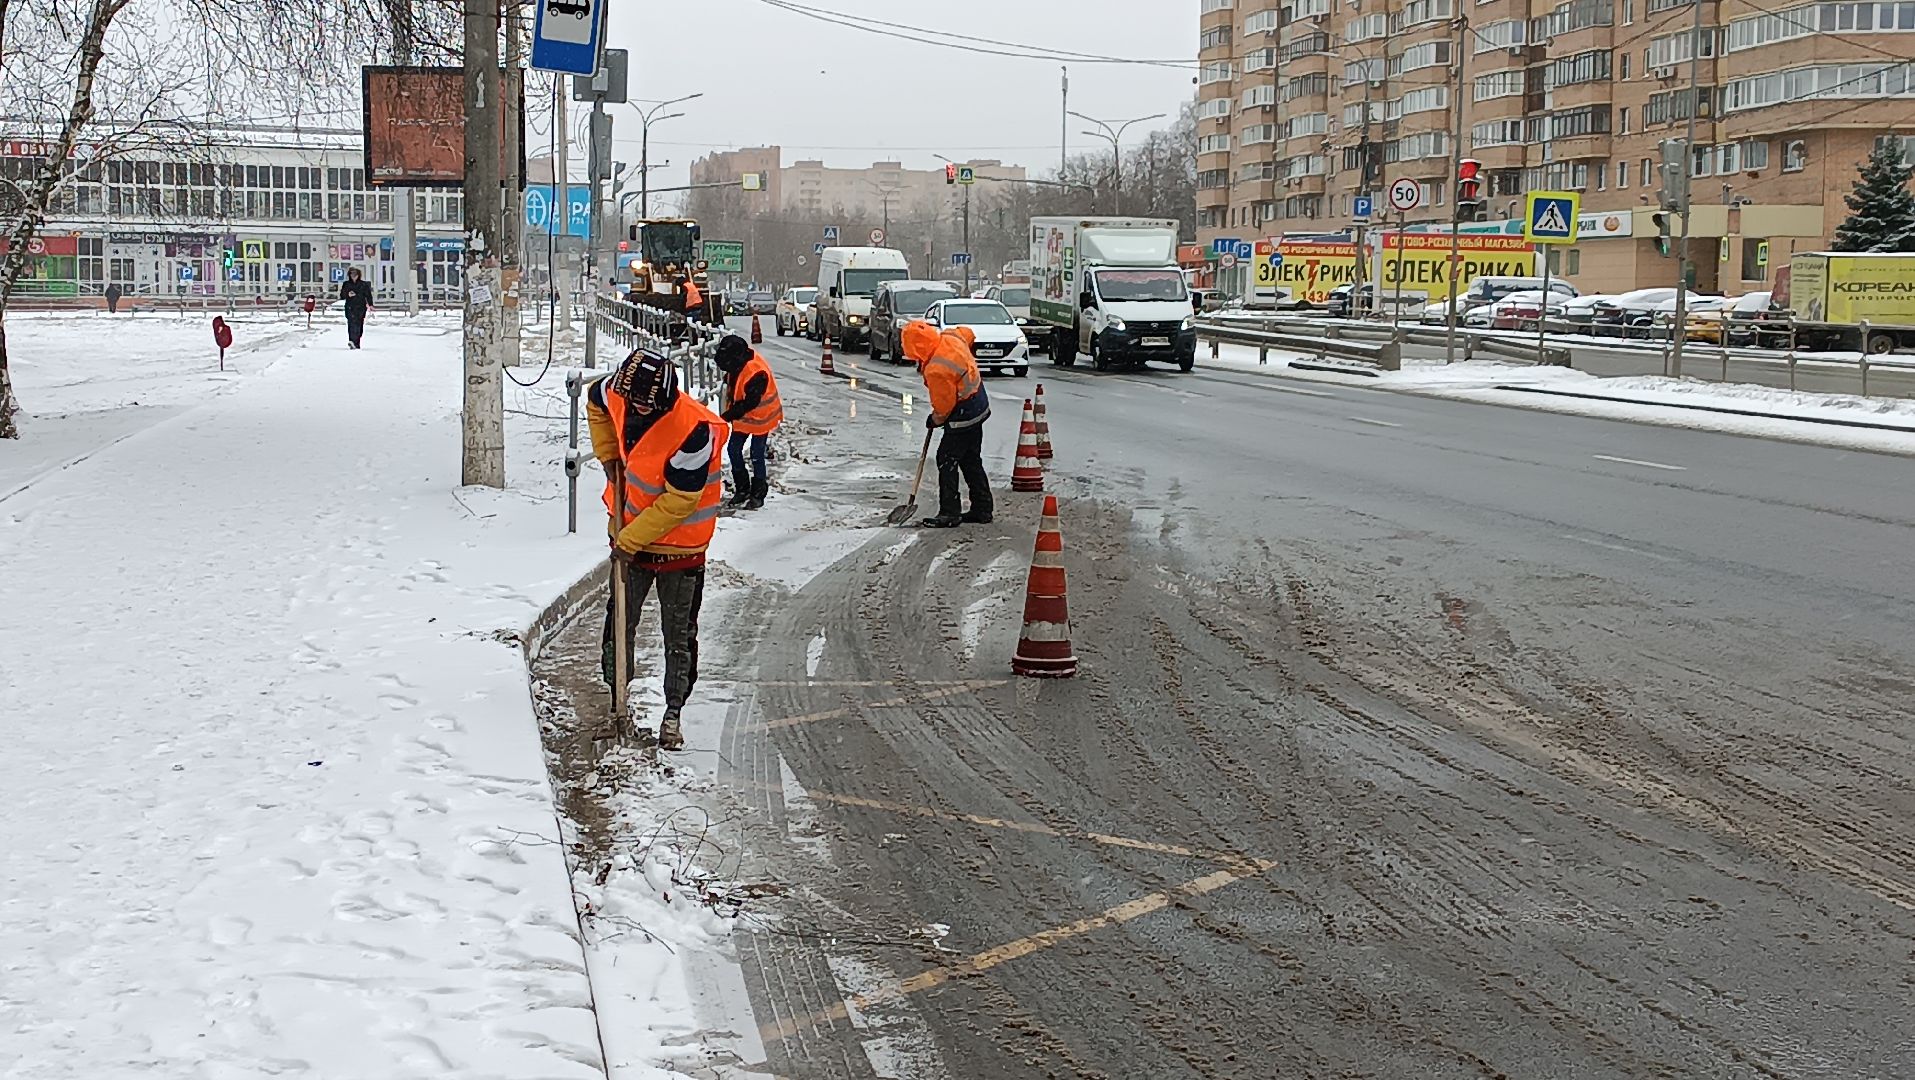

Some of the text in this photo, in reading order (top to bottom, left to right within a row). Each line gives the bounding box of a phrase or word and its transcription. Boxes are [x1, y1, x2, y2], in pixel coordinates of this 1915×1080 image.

[1394, 187, 1415, 202] 50
[1358, 199, 1368, 214] P
[1240, 245, 1250, 257] P
[183, 268, 192, 278] P
[229, 269, 238, 278] P
[280, 269, 288, 278] P
[336, 269, 344, 279] P
